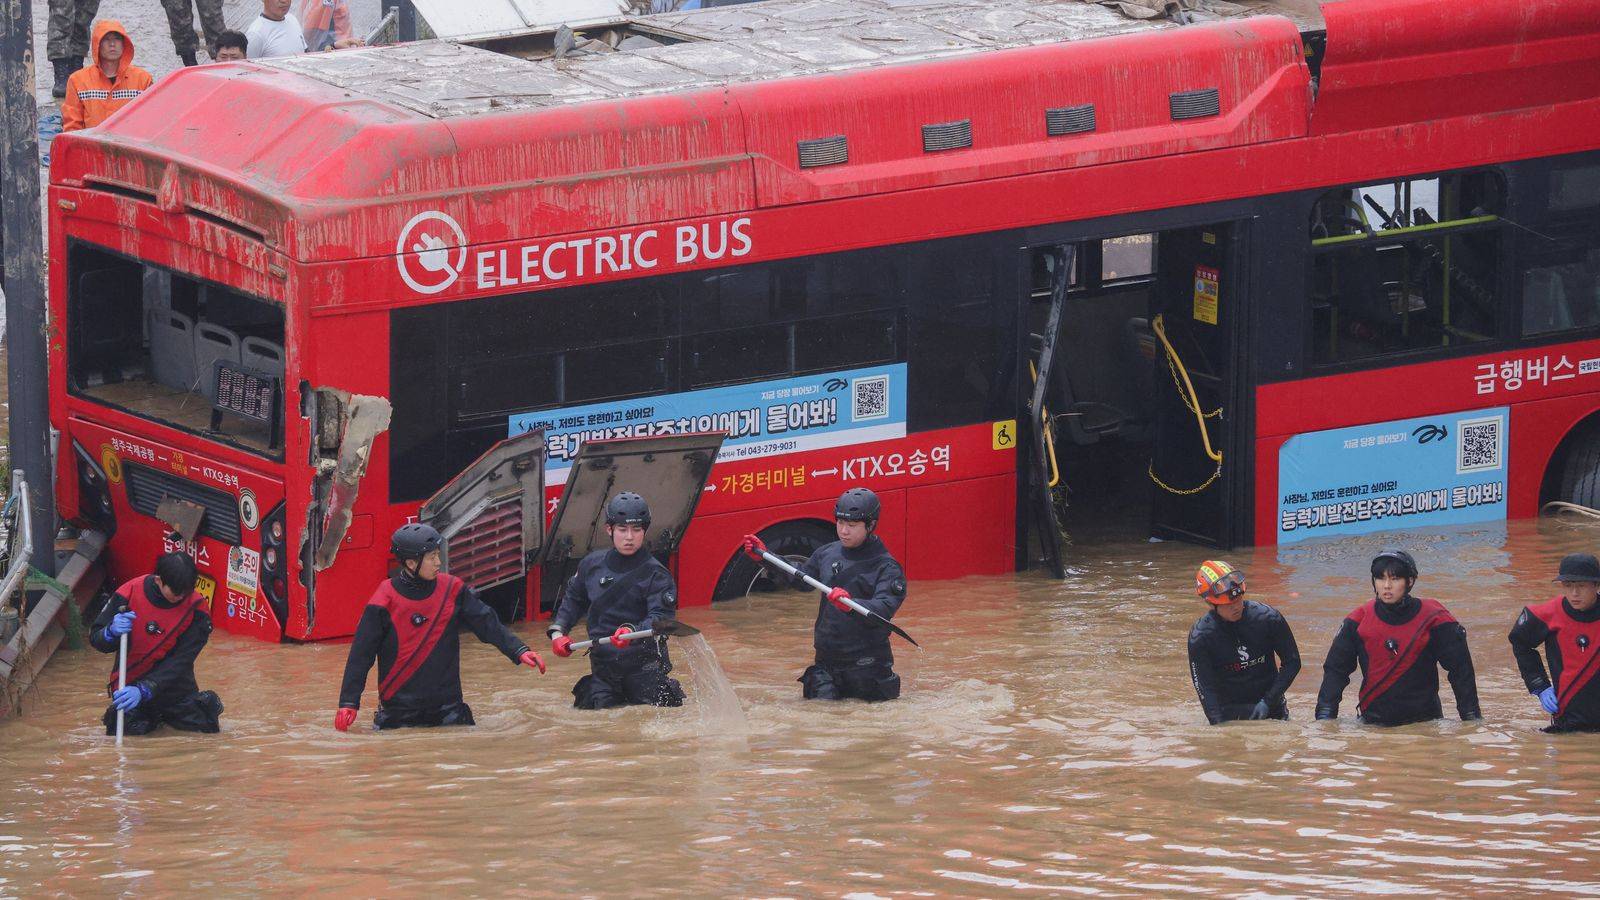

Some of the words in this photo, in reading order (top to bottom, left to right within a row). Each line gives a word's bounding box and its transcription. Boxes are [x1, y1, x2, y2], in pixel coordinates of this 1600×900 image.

[477, 230, 658, 290] ELECTRIC
[675, 218, 753, 265] BUS
[1474, 355, 1576, 395] 급행버스
[761, 391, 775, 401] 지금
[791, 385, 820, 397] 물어보기
[558, 416, 585, 429] 저희도
[587, 411, 622, 426] 훈련하고
[625, 406, 654, 420] 싶어요!
[767, 397, 837, 433] 물어봐!
[111, 437, 155, 462] 청주국제공항
[737, 448, 747, 457] Tel
[1344, 438, 1359, 449] 지금
[1360, 436, 1376, 447] 당장
[1377, 432, 1407, 445] 물어보기
[202, 466, 239, 489] KTX오송역
[722, 465, 805, 495] 가경터미널
[842, 445, 950, 481] KTX오송역
[1283, 493, 1309, 504] 사장님,
[1311, 489, 1335, 501] 저희도
[1337, 485, 1369, 498] 훈련하고
[1371, 481, 1398, 493] 싶어요!
[1282, 489, 1448, 531] 능력개발전담주치의에게
[1452, 481, 1502, 509] 물어봐!
[243, 552, 258, 576] 주의
[226, 591, 269, 627] 동일운수
